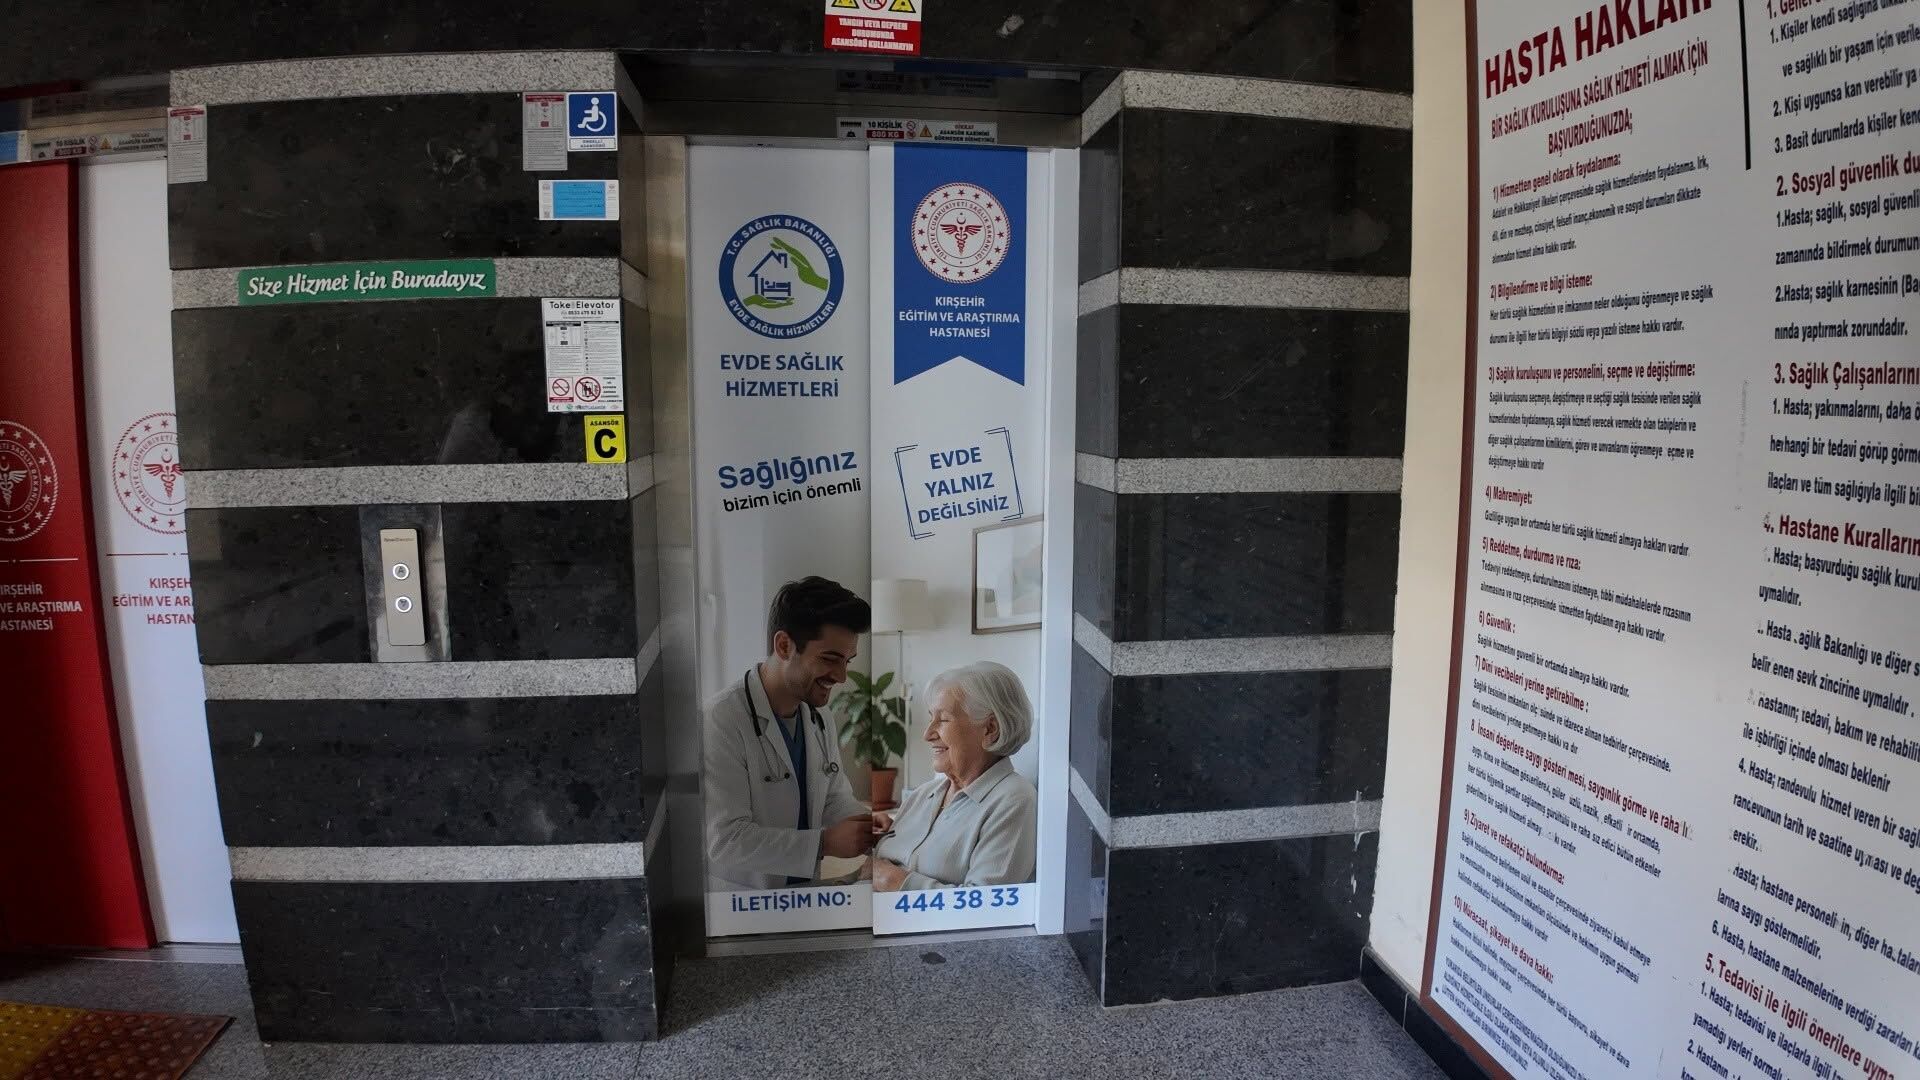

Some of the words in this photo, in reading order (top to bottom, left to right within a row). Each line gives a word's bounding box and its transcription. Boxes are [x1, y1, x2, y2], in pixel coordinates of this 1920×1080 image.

[1770, 29, 1778, 44] 1.
[1781, 21, 1808, 42] Kişiler
[1811, 8, 1835, 31] kendi
[1485, 26, 1566, 99] HASTA
[1575, 0, 1712, 61] HAKLA
[1783, 63, 1793, 77] ve
[1795, 49, 1827, 74] sağlıklı
[1830, 45, 1842, 63] bir
[1845, 39, 1874, 62] yaşam
[1876, 31, 1894, 54] için
[1491, 114, 1503, 139] BİR
[1504, 108, 1529, 136] SAĞLIK
[1531, 93, 1582, 126] KURULUŞUNA
[1583, 76, 1613, 107] SAĞLIK
[1615, 56, 1651, 95] HİZMETİ
[1653, 49, 1685, 82] ALMAK
[1687, 37, 1708, 76] İÇİN
[1773, 100, 1782, 117] 2.
[1785, 95, 1801, 116] Kişi
[1804, 87, 1842, 111] uygunsa
[1845, 82, 1861, 99] kan
[1864, 68, 1902, 93] verebilir
[1905, 68, 1917, 88] ya
[878, 121, 902, 129] KİŞİLİK
[1775, 137, 1783, 153] 3.
[1786, 131, 1808, 151] Basit
[1812, 118, 1864, 145] durumlarda
[1868, 112, 1897, 136] kişiler
[1500, 179, 1532, 198] Hizmetten
[1533, 171, 1550, 192] genel
[1553, 165, 1574, 183] olarak
[1576, 154, 1621, 179] faydalanma:
[1777, 175, 1788, 196] 2.
[1792, 166, 1835, 195] Sosyal
[1840, 154, 1899, 191] güvenlik
[1816, 201, 1847, 223] sağlık,
[1850, 195, 1880, 218] sosyal
[727, 238, 743, 255] T.C.
[742, 219, 781, 239] SAĞLIK
[785, 219, 835, 257] BAKANLIĞI
[1776, 244, 1824, 265] zamanında
[1827, 238, 1872, 259] bildirmek
[247, 277, 282, 297] Size
[287, 273, 349, 295] Hizmet
[354, 271, 386, 293] İçin
[391, 271, 486, 292] Buradayız
[1498, 281, 1538, 300] Bilgilendirme
[1539, 280, 1548, 291] ve
[1550, 276, 1564, 293] bilgi
[1566, 274, 1592, 288] isteme:
[1816, 280, 1844, 302] sağlık
[1847, 276, 1898, 297] karnesinin
[936, 295, 984, 308] KIRŞEHİR
[729, 299, 750, 322] EVDE
[749, 320, 783, 336] SAĞLIK
[899, 309, 938, 322] EĞİTİM
[940, 312, 953, 322] VE
[956, 312, 1019, 325] ARAŞTIRMA
[929, 326, 990, 338] HASTANESİ
[721, 355, 771, 371] EVDE
[776, 352, 843, 371] SAĞLIK
[1496, 367, 1515, 383] Sağlık
[1516, 366, 1551, 384] kuruluşunu
[1554, 367, 1561, 379] ve
[1563, 363, 1605, 382] personelini,
[1607, 364, 1632, 382] seçme
[1635, 365, 1644, 378] ve
[1647, 361, 1695, 381] değiştirme:
[726, 378, 839, 397] HİZMETLERİ
[1774, 363, 1785, 384] 3.
[1789, 362, 1828, 389] Sağlık
[594, 429, 617, 458] C
[718, 452, 857, 489] Sağlığınız
[930, 447, 982, 469] EVDE
[723, 494, 769, 512] bizim
[773, 489, 801, 504] için
[806, 478, 861, 498] önemli
[925, 472, 994, 498] YALNIZ
[1493, 486, 1532, 506] Mahremiyet:
[918, 495, 1009, 523] DEĞİLSİNİZ
[1779, 515, 1839, 542] Hastane
[1489, 538, 1522, 560] Reddetme,
[1524, 545, 1554, 564] durdurma
[1556, 553, 1564, 566] ve
[1805, 553, 1859, 581] başvurduğu
[1862, 566, 1891, 587] sağlık
[0, 582, 43, 597] IRŞEHİR
[150, 578, 192, 591] KIRŞEH
[1759, 585, 1802, 606] uymalıdır.
[0, 602, 14, 613] VE
[16, 601, 82, 615] ARAŞTIRMA
[113, 594, 153, 606] EĞİTİM
[156, 596, 171, 606] VE
[0, 618, 53, 631] ASTANESİ
[147, 614, 195, 624] HASTAN
[1824, 634, 1868, 665] Bakanlığı
[1871, 650, 1882, 666] ve
[1885, 652, 1912, 675] diğer
[1743, 722, 1753, 739] ile
[1755, 727, 1788, 755] işbirliği
[1789, 739, 1816, 764] içinde
[1818, 752, 1849, 776] olması
[1851, 762, 1890, 792] beklenir
[1738, 758, 1746, 774] 4.
[1749, 760, 1776, 788] Hasta;
[1777, 775, 1817, 803] randevulu
[1820, 790, 1852, 818] hizmet
[1854, 807, 1880, 829] veren
[1882, 816, 1897, 836] bir
[732, 892, 811, 912] İLETİŞİM
[818, 891, 851, 906] NO:
[895, 892, 945, 913] 444
[953, 890, 983, 909] 38
[991, 887, 1019, 907] 33
[1711, 920, 1719, 936] 6.
[1748, 941, 1780, 971] hastane
[1782, 964, 1843, 1010] malzemelerine
[1705, 953, 1714, 973] 5.
[1718, 960, 1764, 1004] Tedavisi
[1765, 989, 1779, 1012] ile
[1781, 1001, 1808, 1031] ilgili
[1809, 1017, 1861, 1066] önerilere
